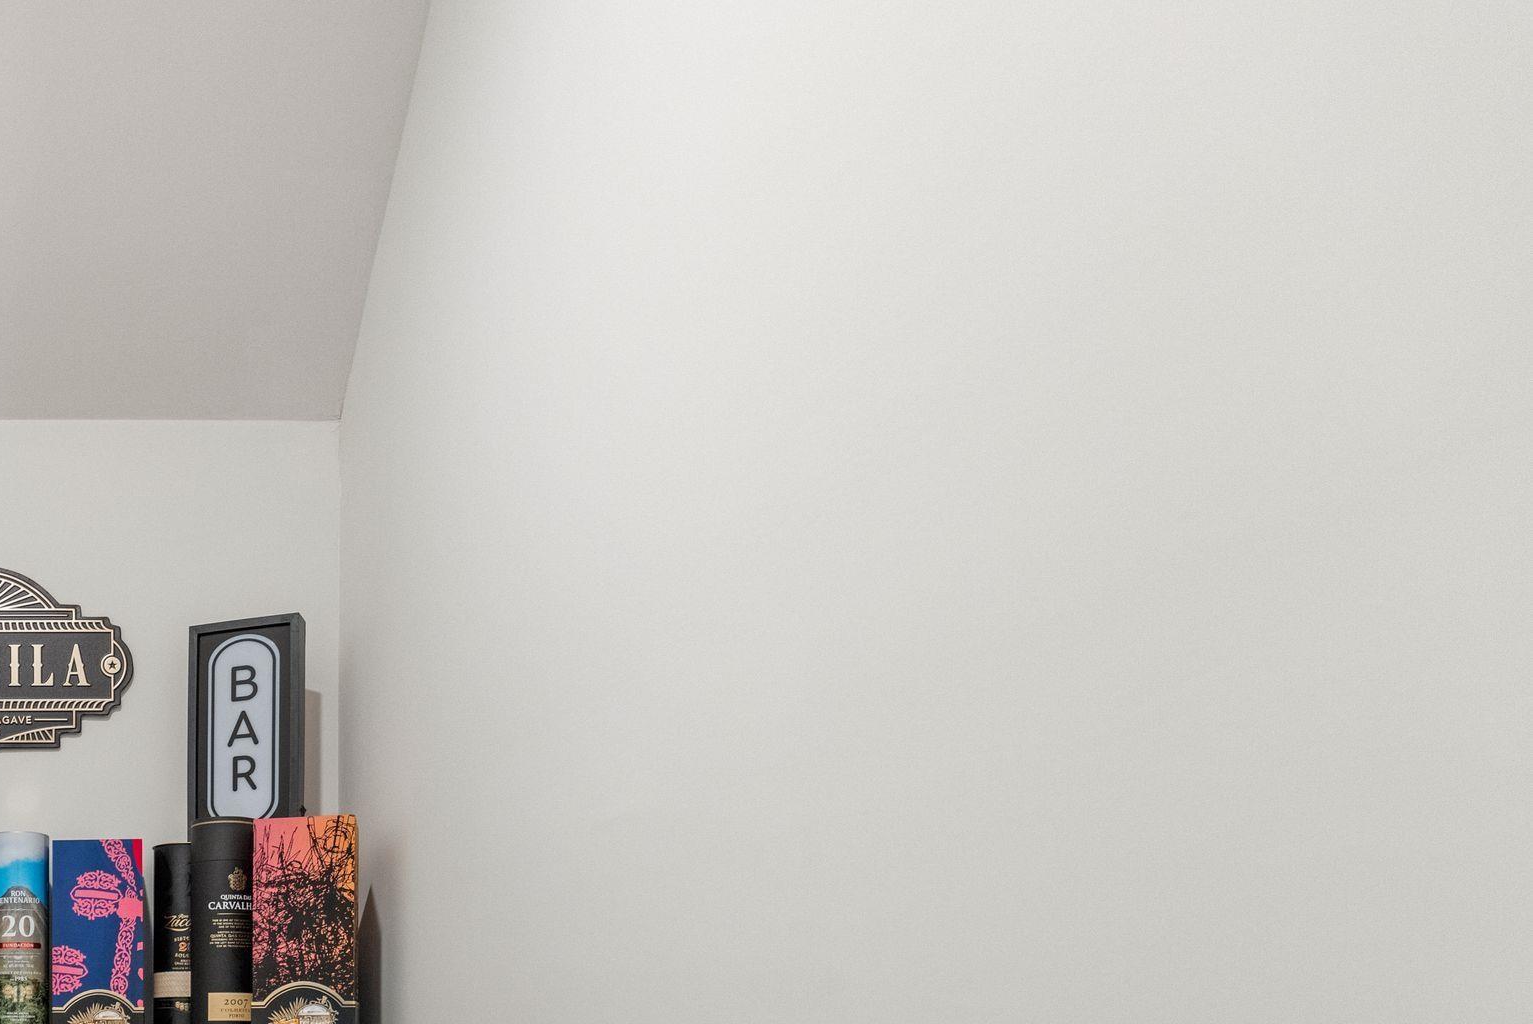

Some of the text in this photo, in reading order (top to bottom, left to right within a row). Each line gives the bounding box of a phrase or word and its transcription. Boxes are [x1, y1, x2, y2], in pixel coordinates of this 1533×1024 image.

[227, 664, 259, 792] BAR
[208, 901, 252, 910] CARVALH
[1, 915, 35, 937] 20
[224, 999, 248, 1008] 2007
